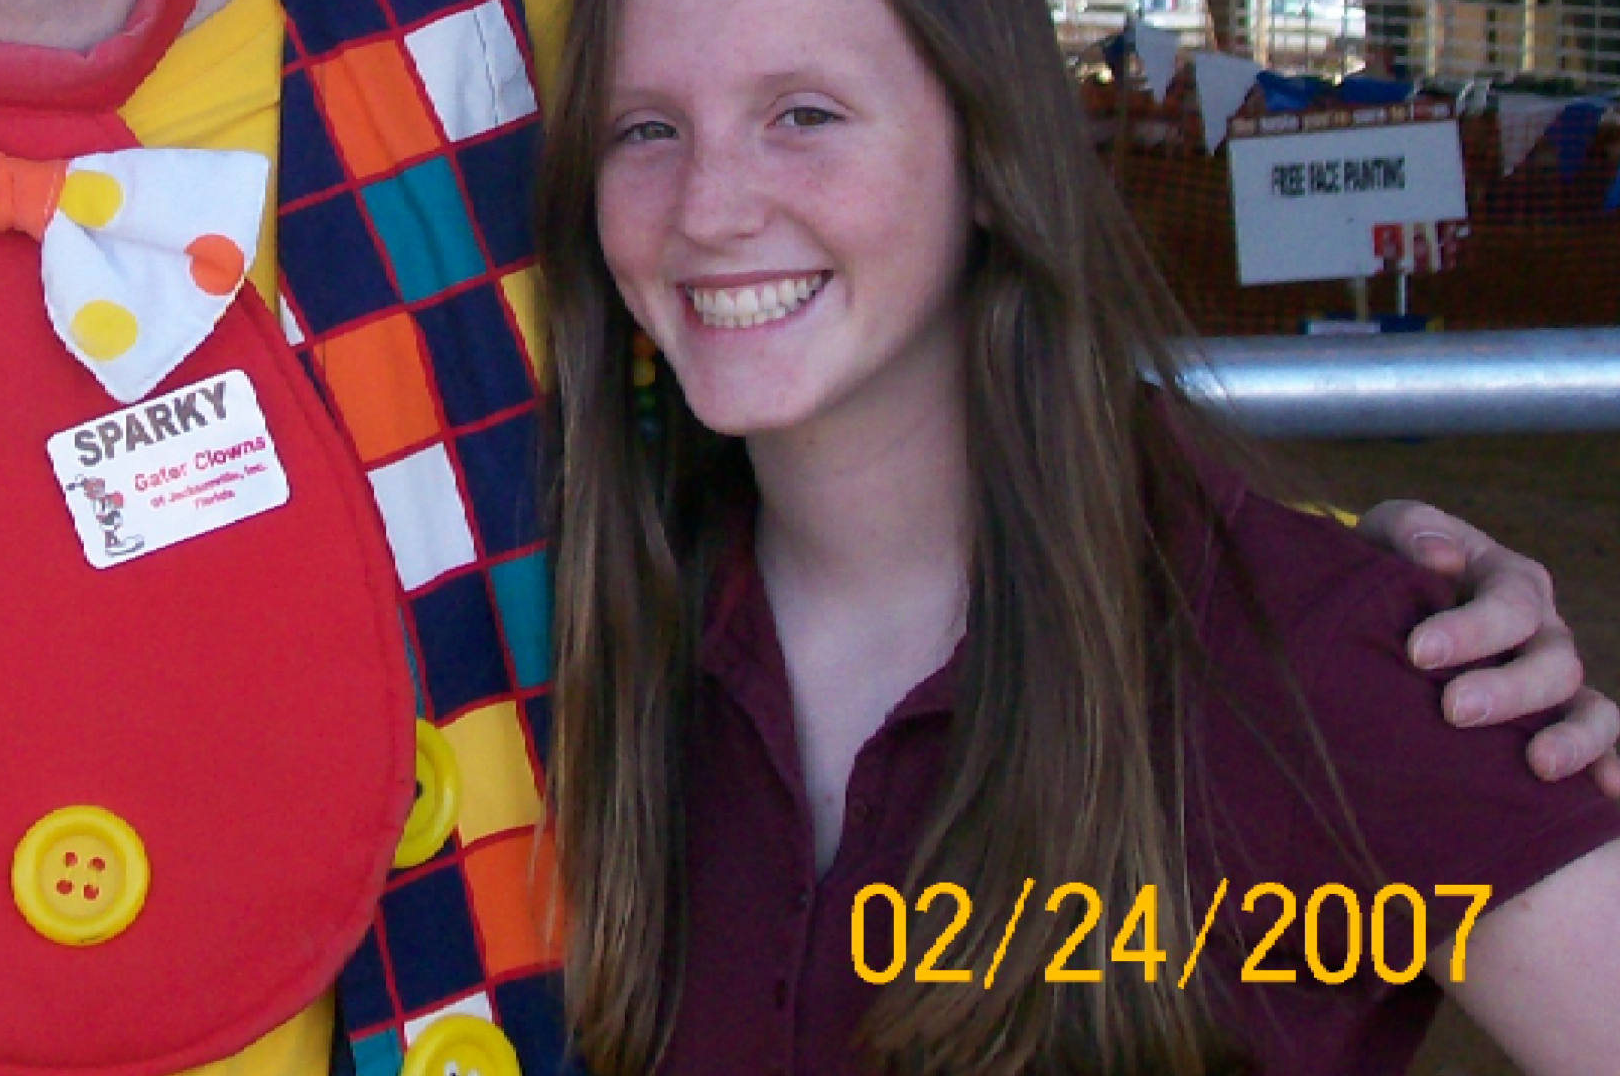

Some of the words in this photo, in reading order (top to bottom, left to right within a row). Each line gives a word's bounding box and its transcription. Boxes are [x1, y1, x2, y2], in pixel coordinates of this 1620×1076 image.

[1271, 162, 1305, 197] FREE
[1308, 159, 1341, 194] FACE
[1344, 155, 1405, 191] PAINTING
[73, 380, 227, 467] SPARKY
[195, 436, 266, 470] Clowns
